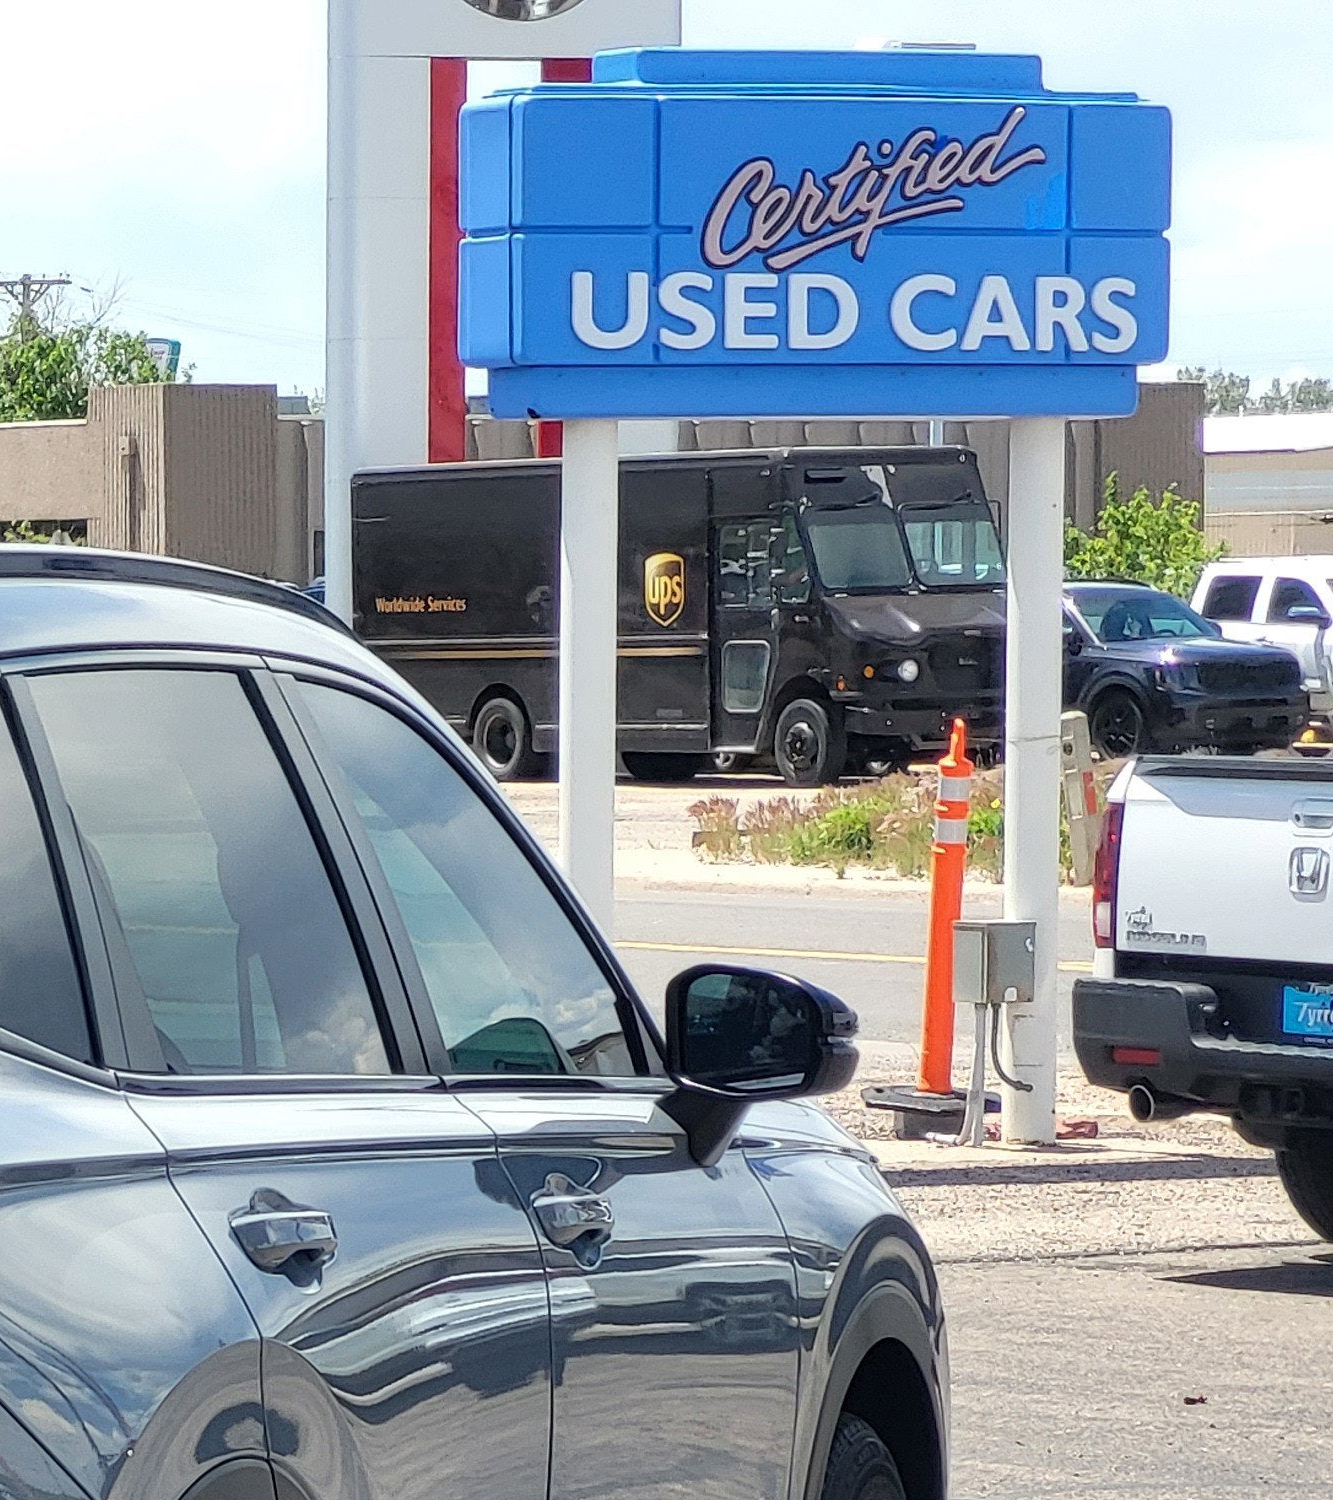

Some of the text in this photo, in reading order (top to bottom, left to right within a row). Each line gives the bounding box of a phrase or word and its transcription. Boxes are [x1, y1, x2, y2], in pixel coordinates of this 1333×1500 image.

[700, 105, 1046, 272] Certified
[569, 271, 1139, 354] USED CARS
[375, 595, 467, 613] Worldwide Services
